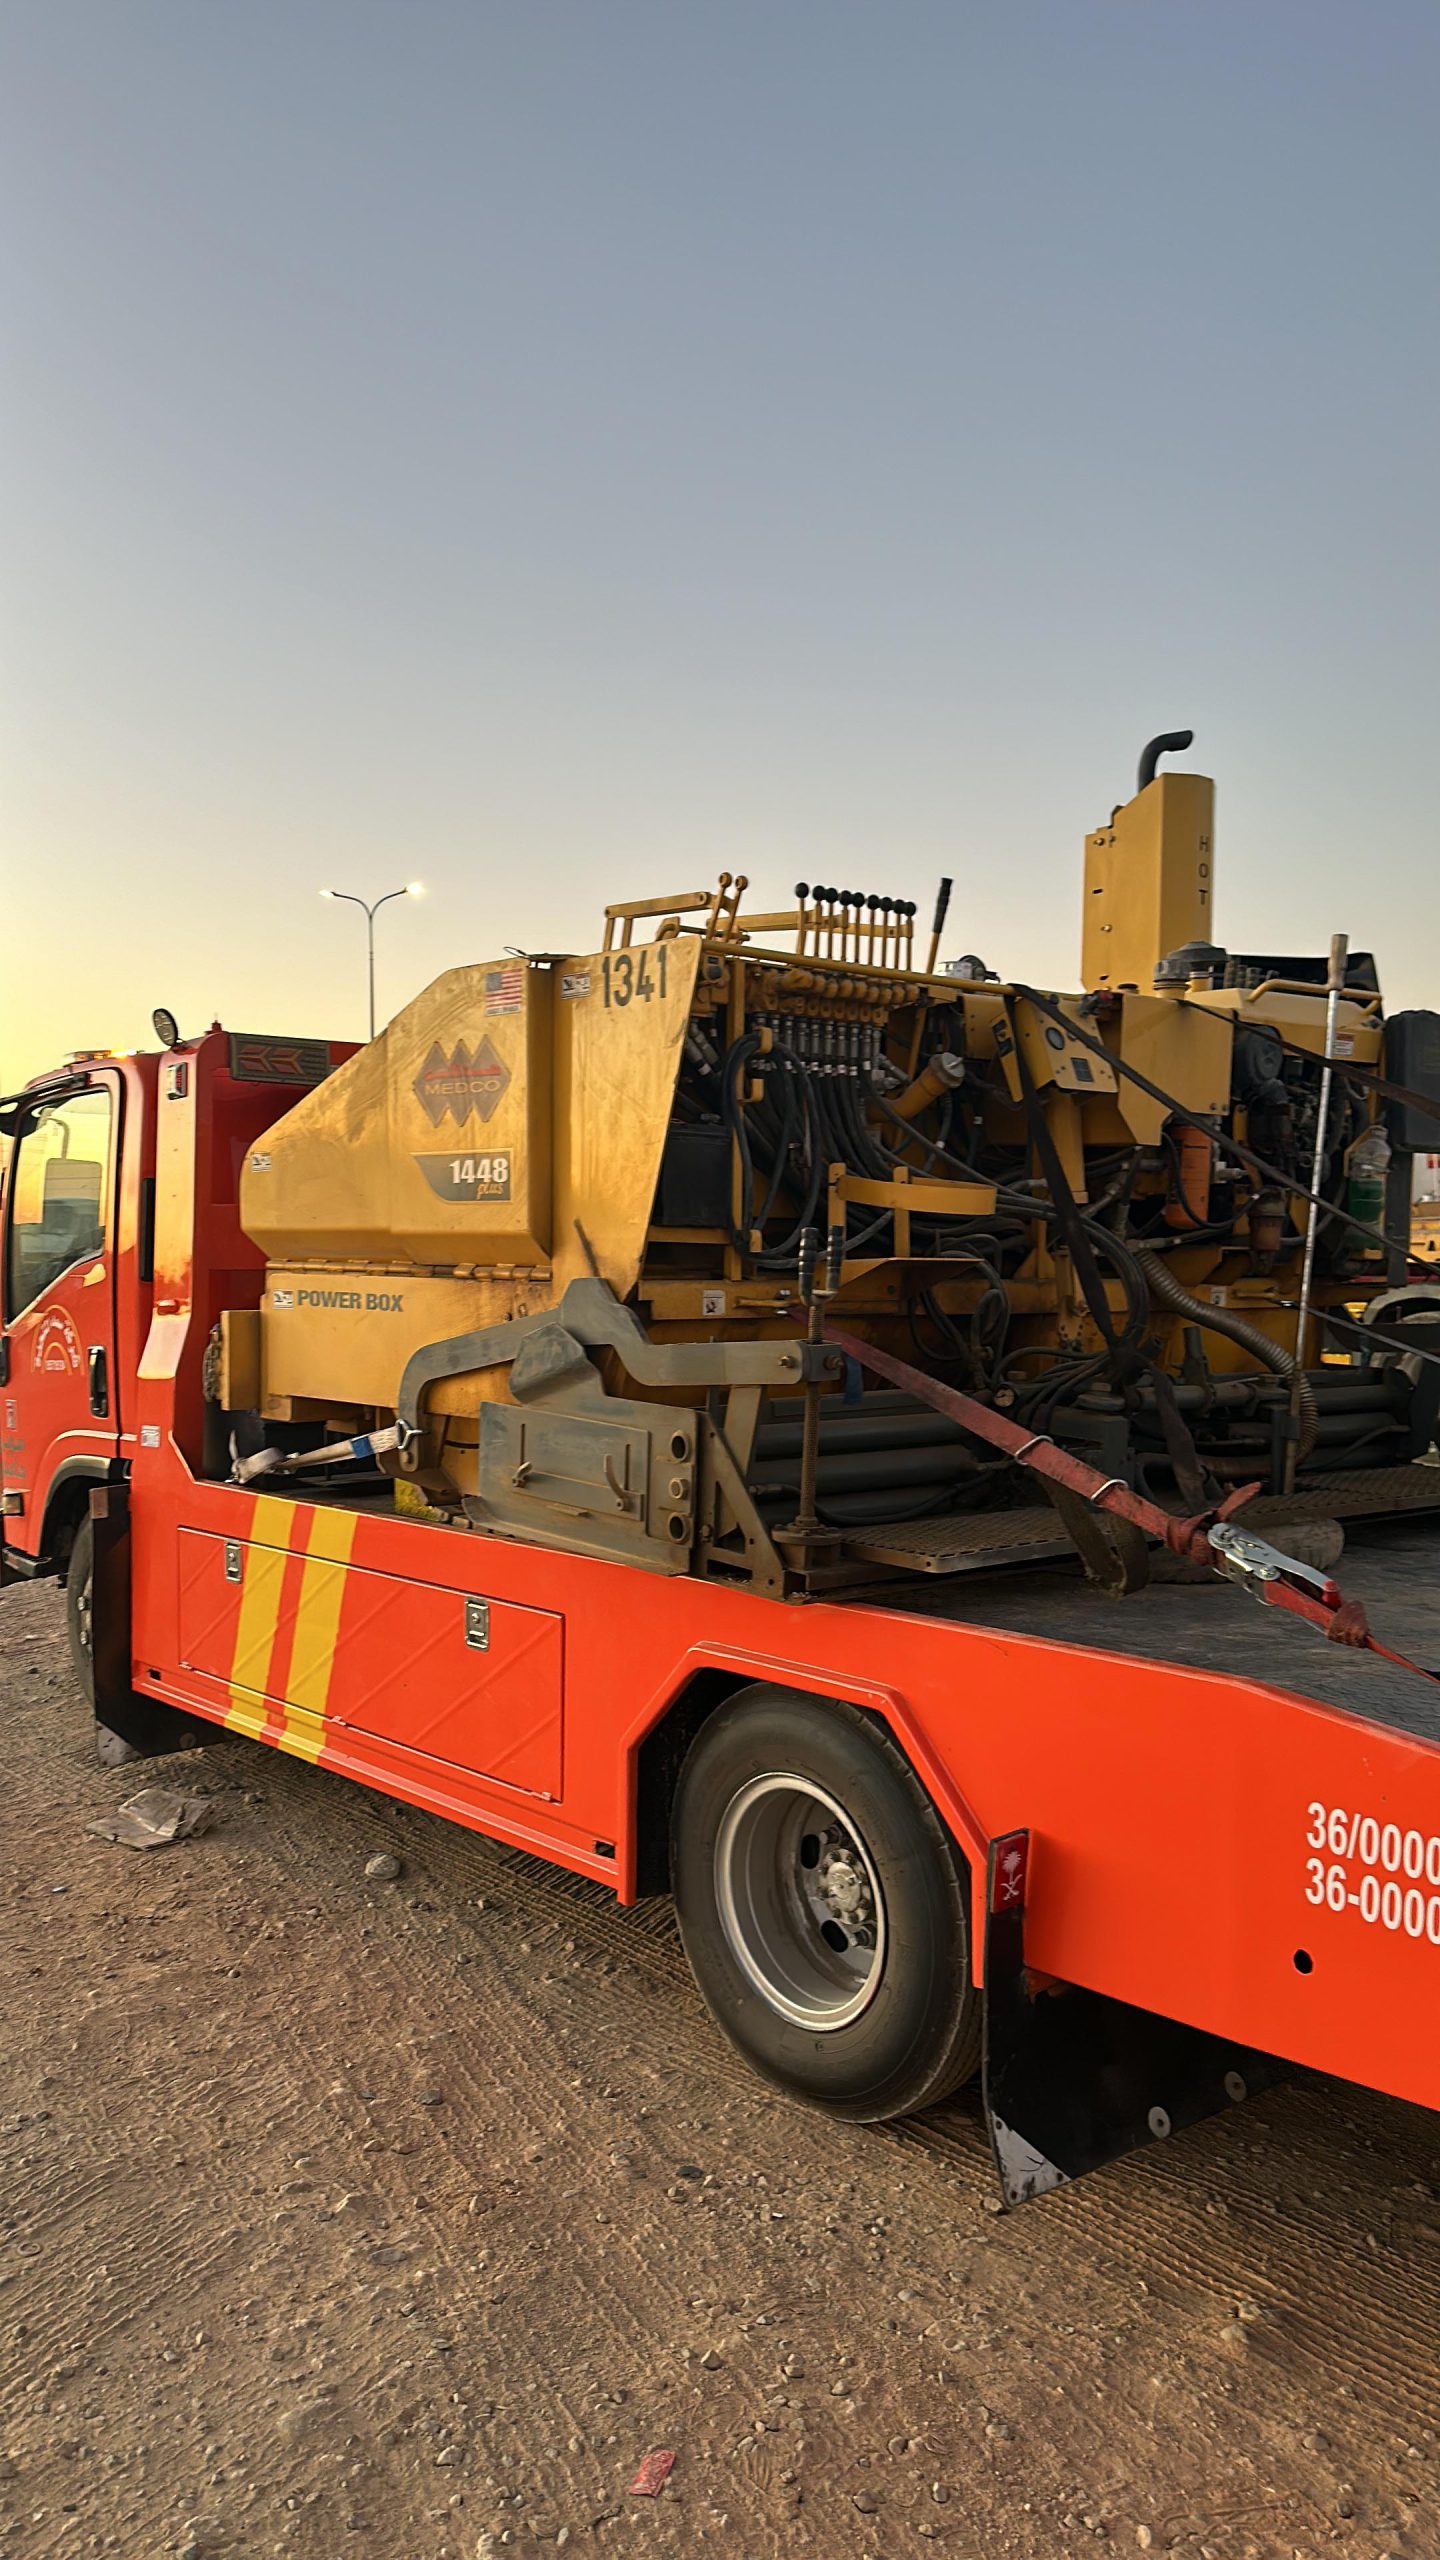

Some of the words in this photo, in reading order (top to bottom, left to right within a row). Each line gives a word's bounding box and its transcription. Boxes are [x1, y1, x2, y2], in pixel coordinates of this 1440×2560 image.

[1199, 835, 1209, 905] HOT
[602, 944, 667, 1008] 1341
[424, 1079, 500, 1096] MEDCO
[449, 1158, 508, 1184] 1448
[297, 1289, 361, 1310] POWER
[365, 1293, 404, 1313] BOX
[1306, 1801, 1440, 1886] 36/0000
[1305, 1857, 1440, 1945] 36-0000
